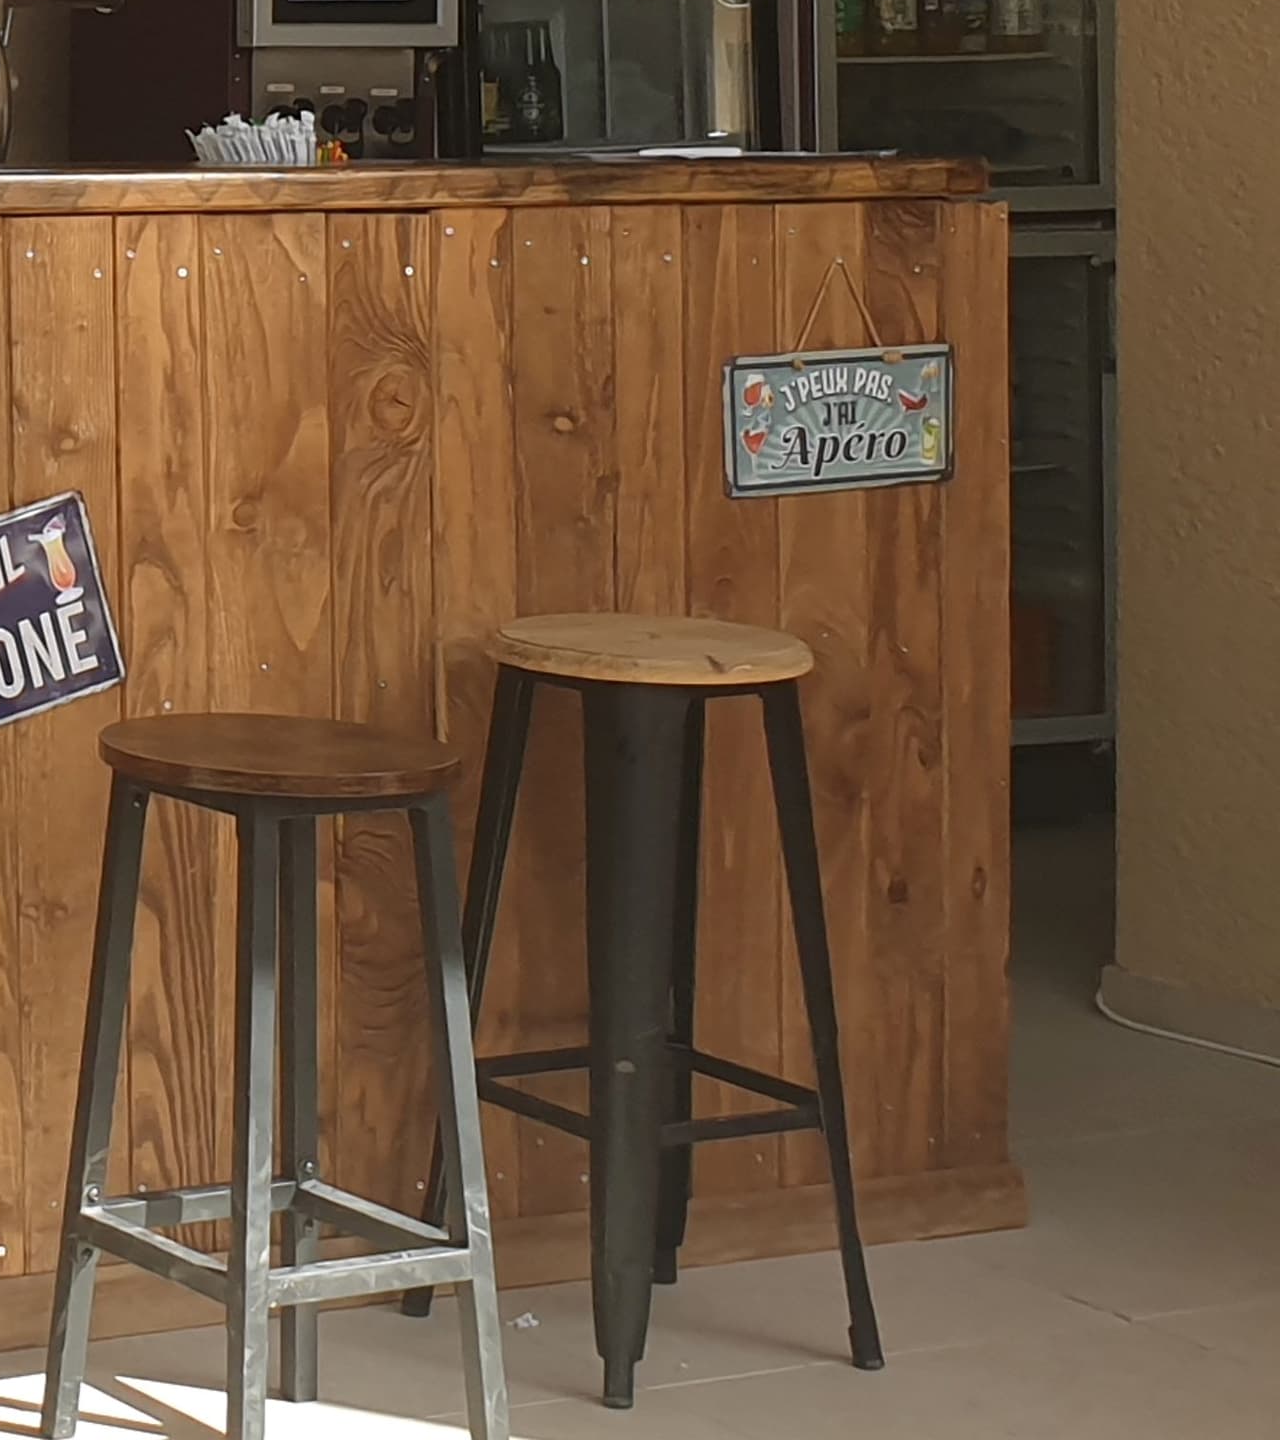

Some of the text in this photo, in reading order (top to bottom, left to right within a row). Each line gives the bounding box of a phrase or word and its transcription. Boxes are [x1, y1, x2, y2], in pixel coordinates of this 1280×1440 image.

[780, 367, 848, 411] J'PEUX
[822, 401, 858, 426] J'AI
[771, 422, 907, 477] Apéro
